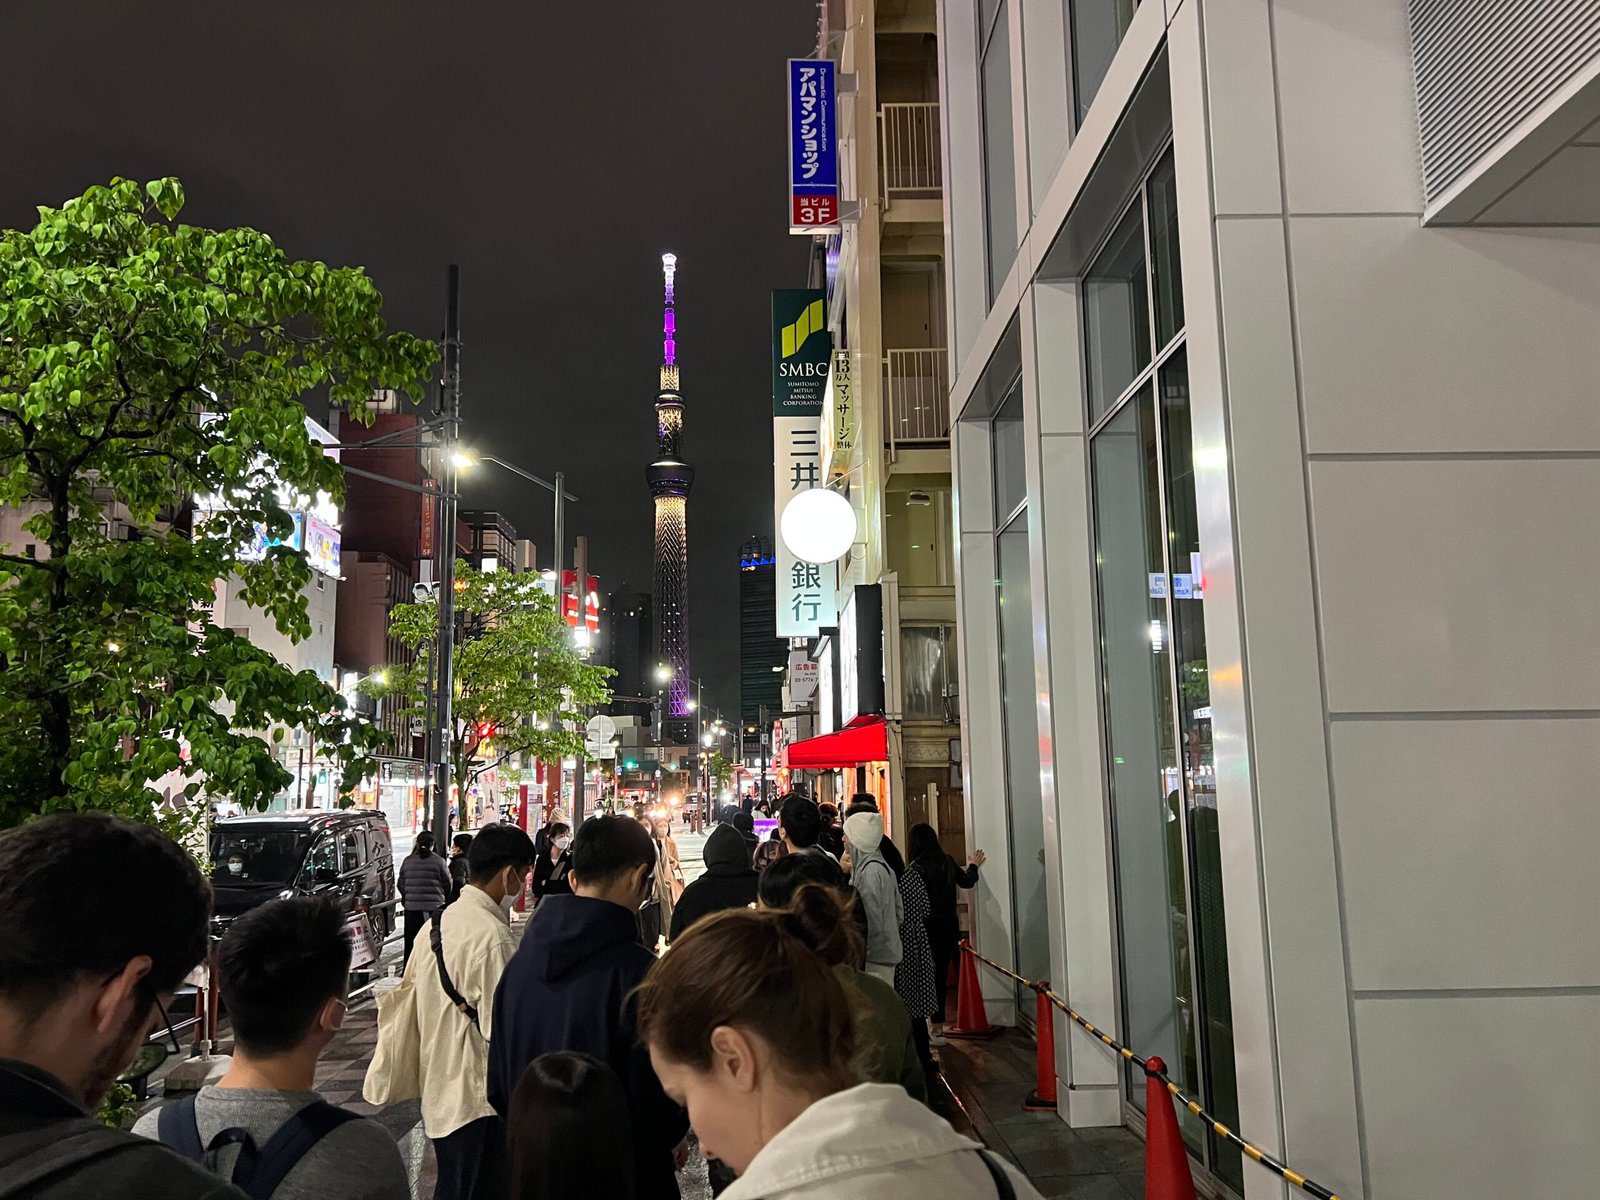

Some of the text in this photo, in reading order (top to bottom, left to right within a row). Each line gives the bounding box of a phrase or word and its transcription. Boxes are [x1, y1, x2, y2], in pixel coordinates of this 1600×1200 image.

[799, 67, 819, 179] アパマンショップ
[800, 197, 830, 207] 当ビル
[800, 207, 830, 223] 3F
[779, 362, 828, 377] SMBC
[835, 359, 851, 373] 13
[836, 384, 850, 440] マッサージ
[790, 430, 822, 622] 三井銀行
